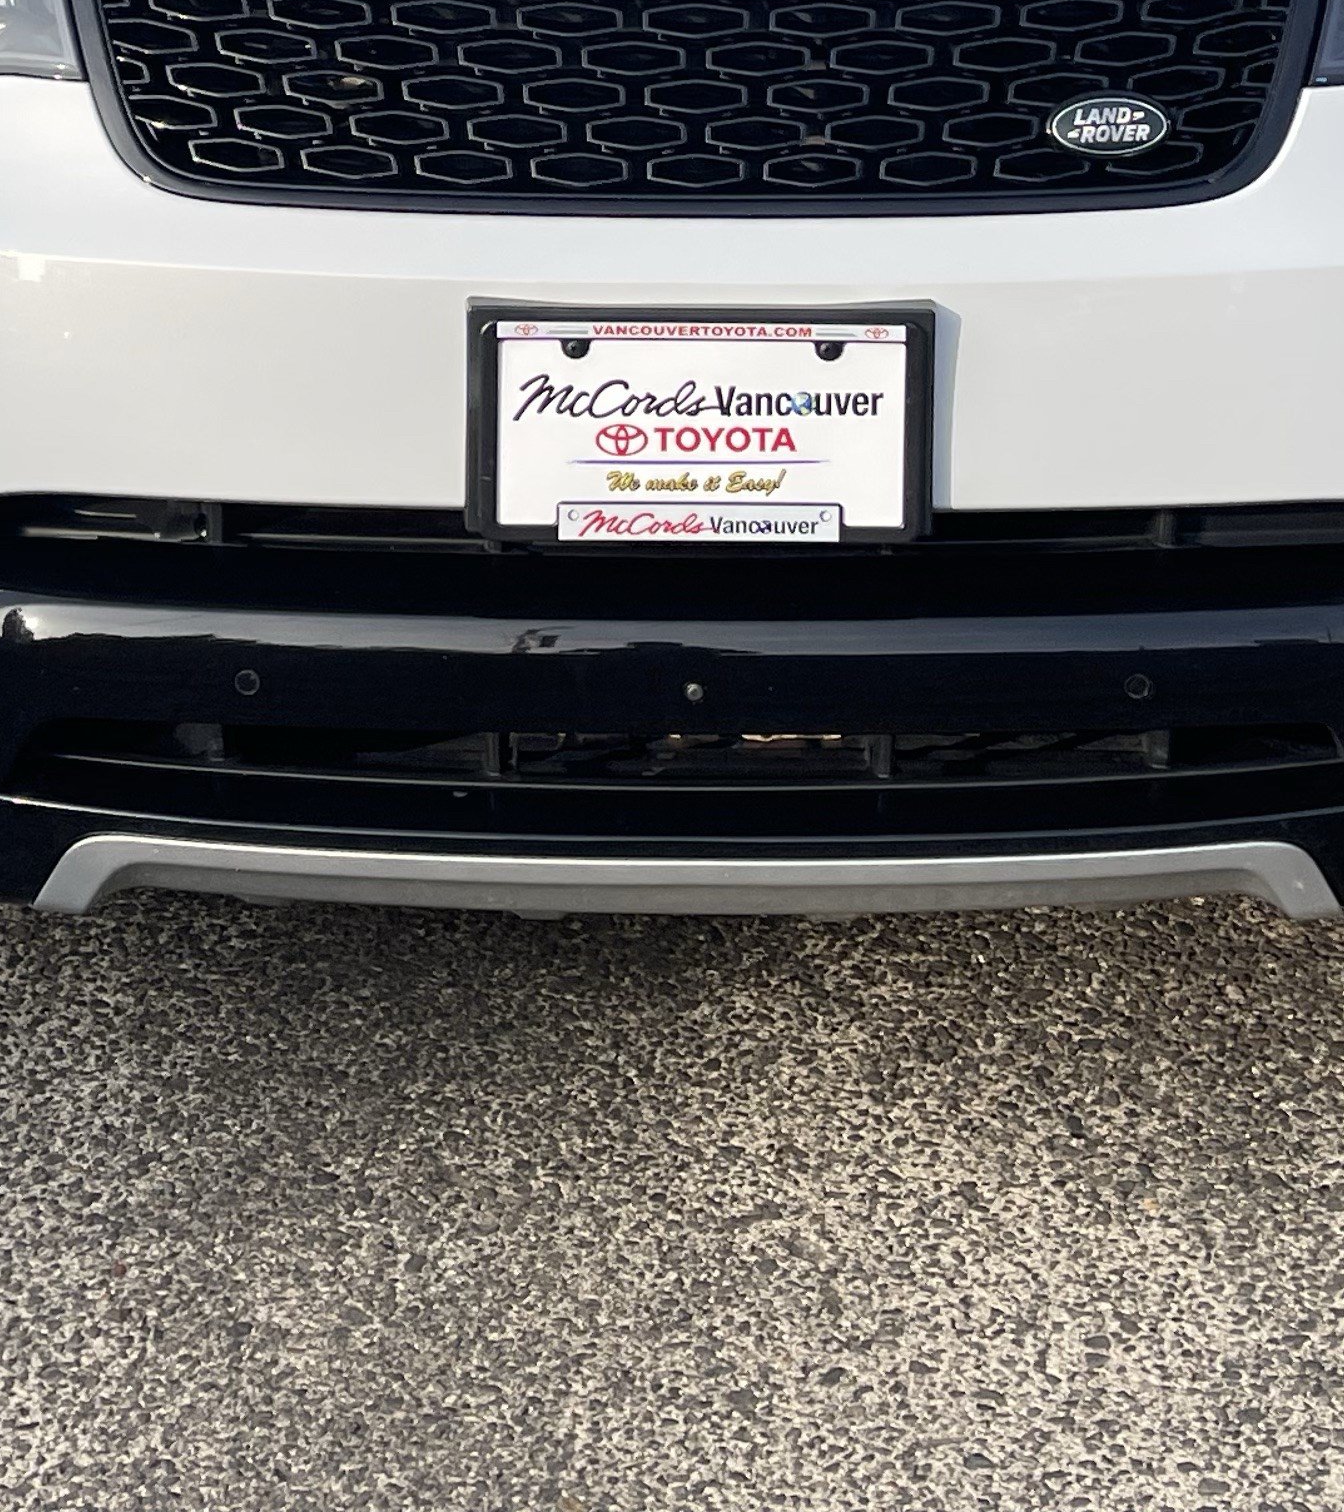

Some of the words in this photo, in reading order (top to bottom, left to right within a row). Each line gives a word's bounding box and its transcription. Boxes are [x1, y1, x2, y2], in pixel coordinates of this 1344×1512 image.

[1073, 106, 1131, 126] LAND
[1079, 124, 1151, 144] ROVER
[592, 324, 812, 338] VANCOUVERTOYOTA.COM
[654, 426, 797, 453] TOYOTA
[606, 470, 641, 492] We
[644, 472, 699, 491] make
[702, 475, 721, 492] it
[725, 468, 787, 496] Easy!
